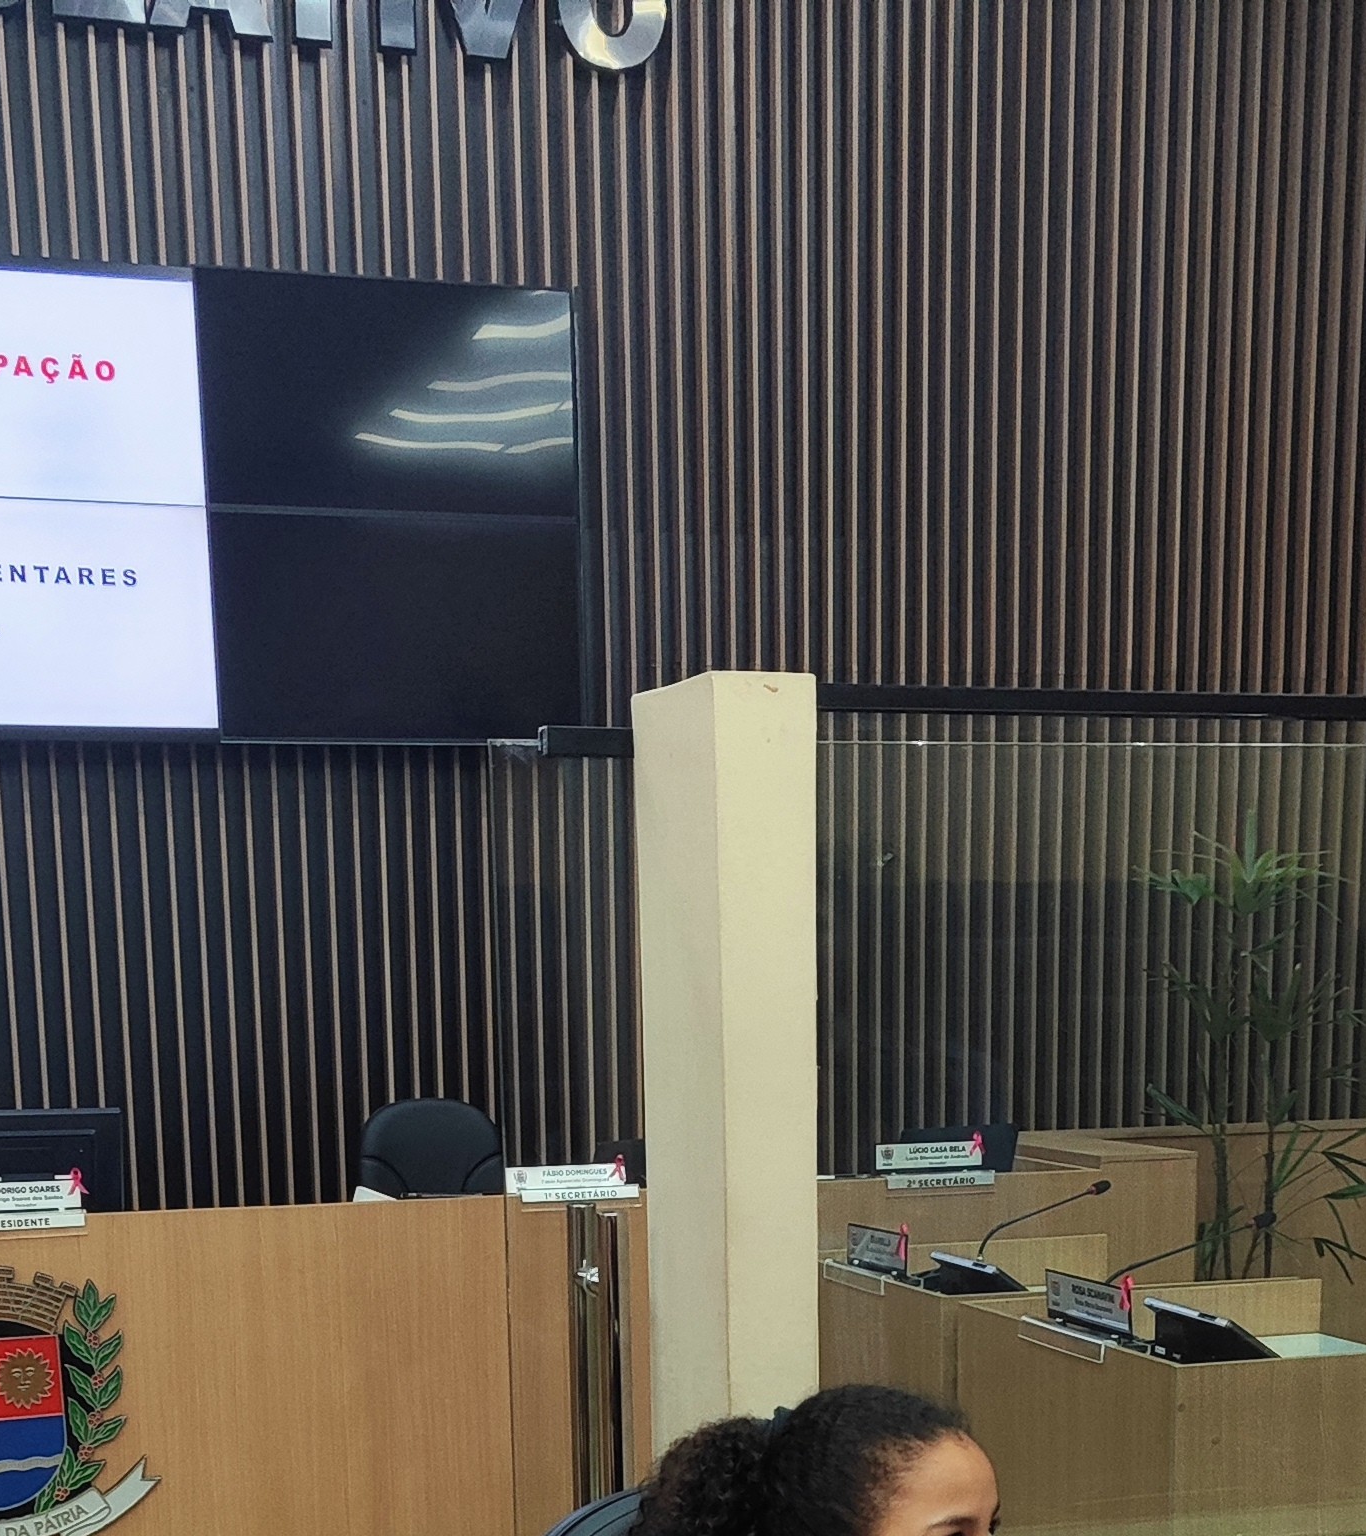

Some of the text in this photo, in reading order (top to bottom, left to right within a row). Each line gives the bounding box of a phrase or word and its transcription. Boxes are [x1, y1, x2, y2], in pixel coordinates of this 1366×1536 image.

[930, 1146, 948, 1154] CASA
[949, 1145, 966, 1153] BELA
[565, 1167, 608, 1177] DOMINGUES
[918, 1176, 976, 1188] SECRETÁRIO
[28, 1185, 61, 1194] SOARES
[554, 1188, 618, 1200] SECRETÁRIO
[33, 1504, 89, 1536] PÁTRIA
